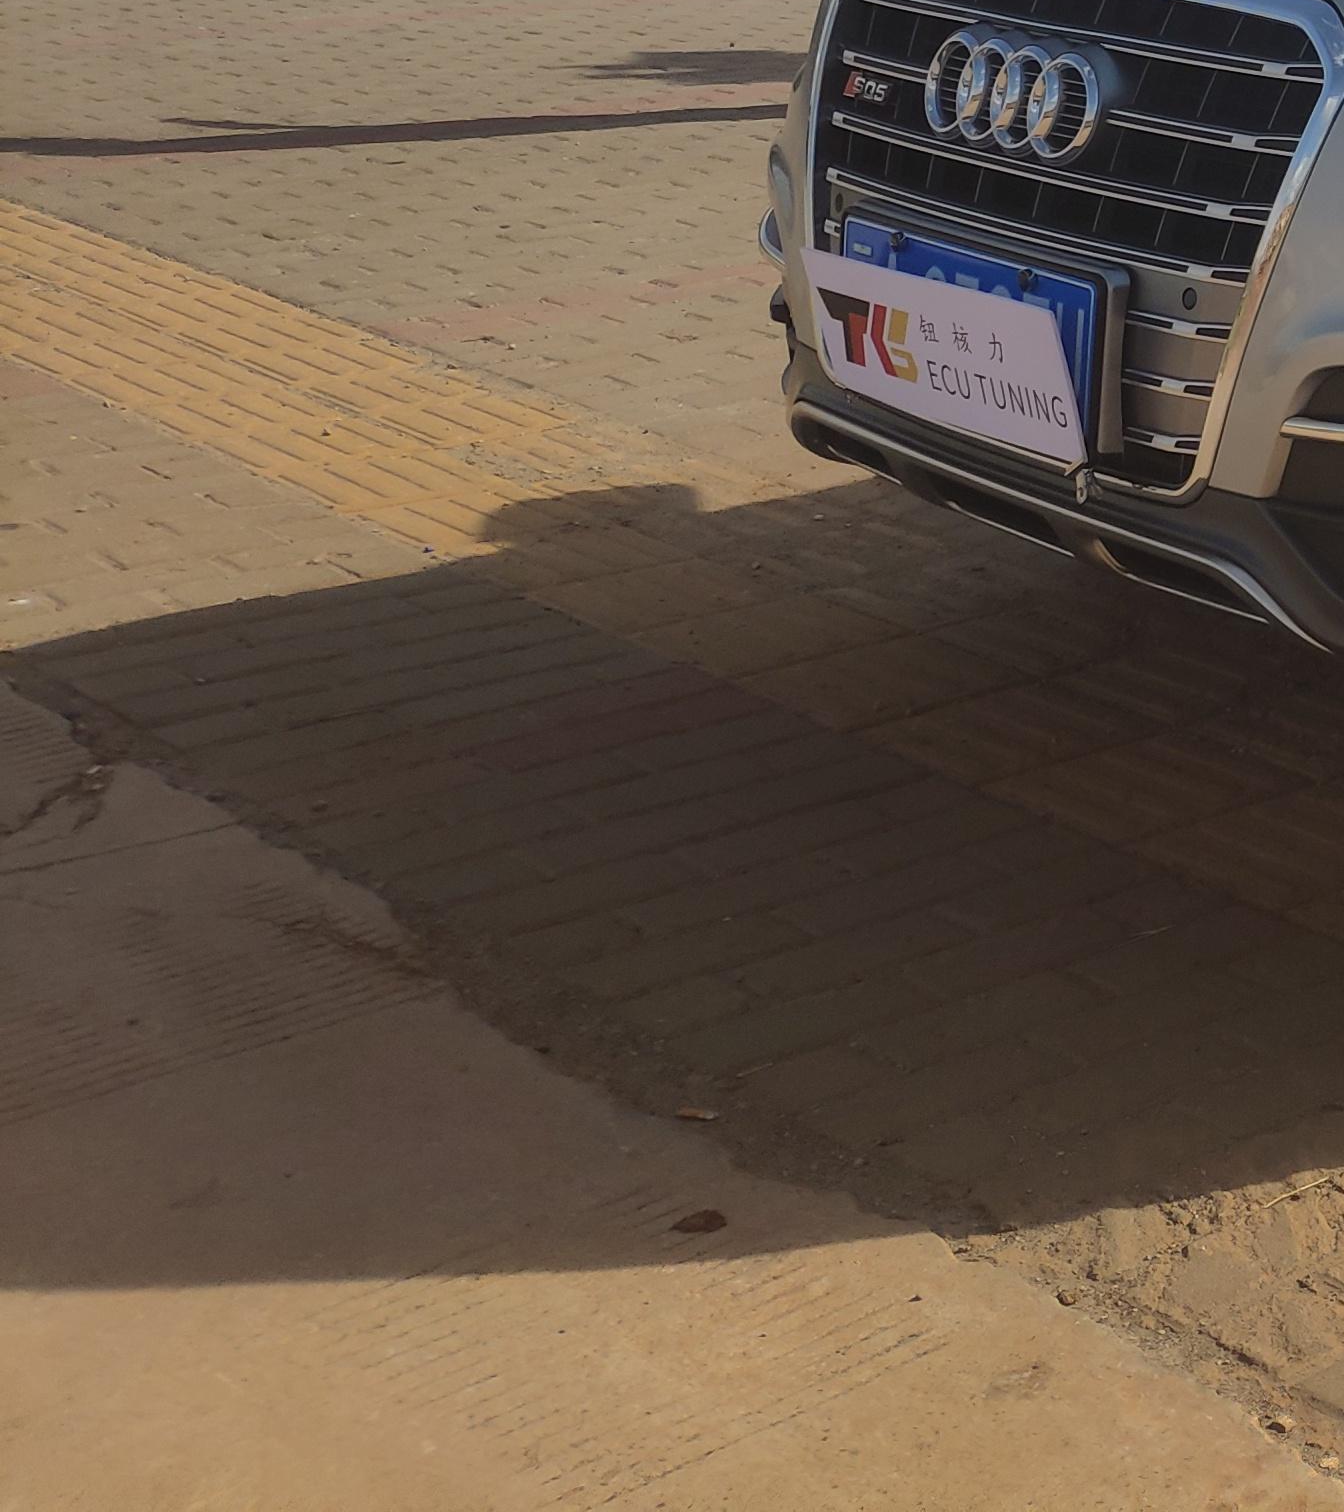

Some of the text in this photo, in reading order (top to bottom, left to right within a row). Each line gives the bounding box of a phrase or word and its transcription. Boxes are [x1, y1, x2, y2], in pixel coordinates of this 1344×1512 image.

[852, 75, 889, 102] SQ5
[926, 359, 1068, 428] ECU TUNING
